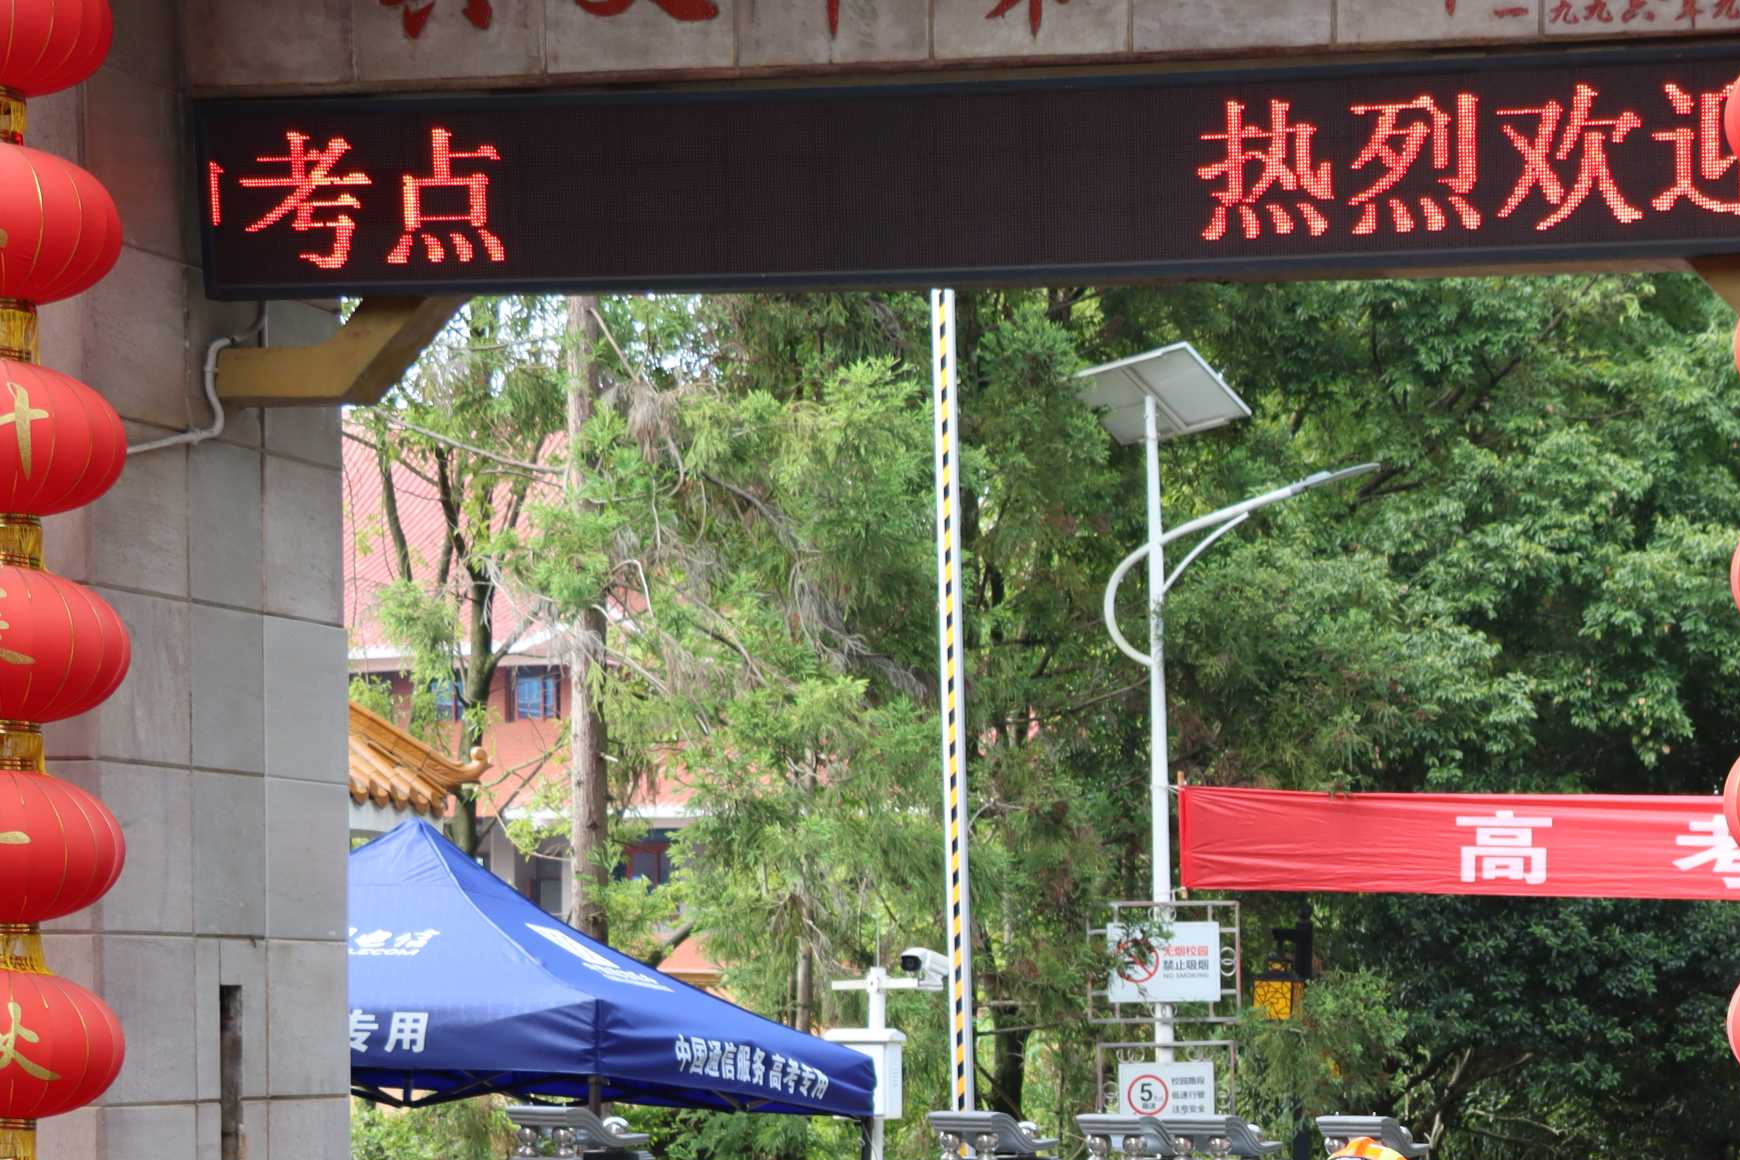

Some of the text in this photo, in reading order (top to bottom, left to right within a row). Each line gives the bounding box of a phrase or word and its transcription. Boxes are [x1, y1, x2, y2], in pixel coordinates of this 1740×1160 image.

[210, 128, 505, 269] 考点
[349, 928, 441, 949] 电信
[675, 1033, 829, 1101] 中国通信服务 高考专用
[1140, 1083, 1153, 1102] 5
